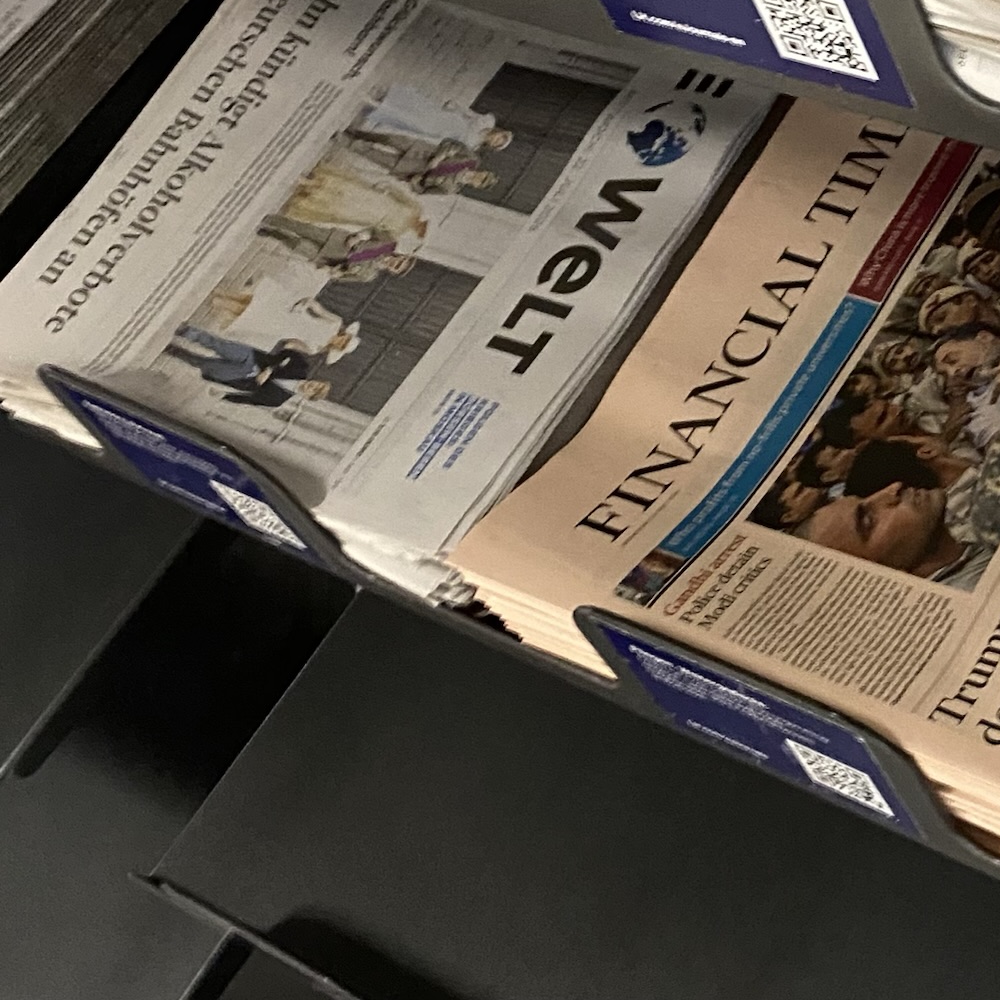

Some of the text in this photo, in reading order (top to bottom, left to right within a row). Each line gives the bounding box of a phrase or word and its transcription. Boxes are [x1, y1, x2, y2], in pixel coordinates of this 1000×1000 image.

[213, 30, 311, 132] kündigt
[68, 106, 204, 250] Bahnhöfen
[36, 248, 79, 286] an
[40, 129, 229, 338] Alkoholverbote
[855, 260, 883, 288] Why
[873, 229, 903, 260] China
[572, 232, 836, 544] FINANCIAL
[802, 115, 911, 231] TIM
[720, 459, 750, 488] from
[773, 371, 812, 417] private
[661, 533, 747, 617] Gandhi arrest
[678, 543, 760, 624] Police detain
[697, 553, 775, 632] Modi critics
